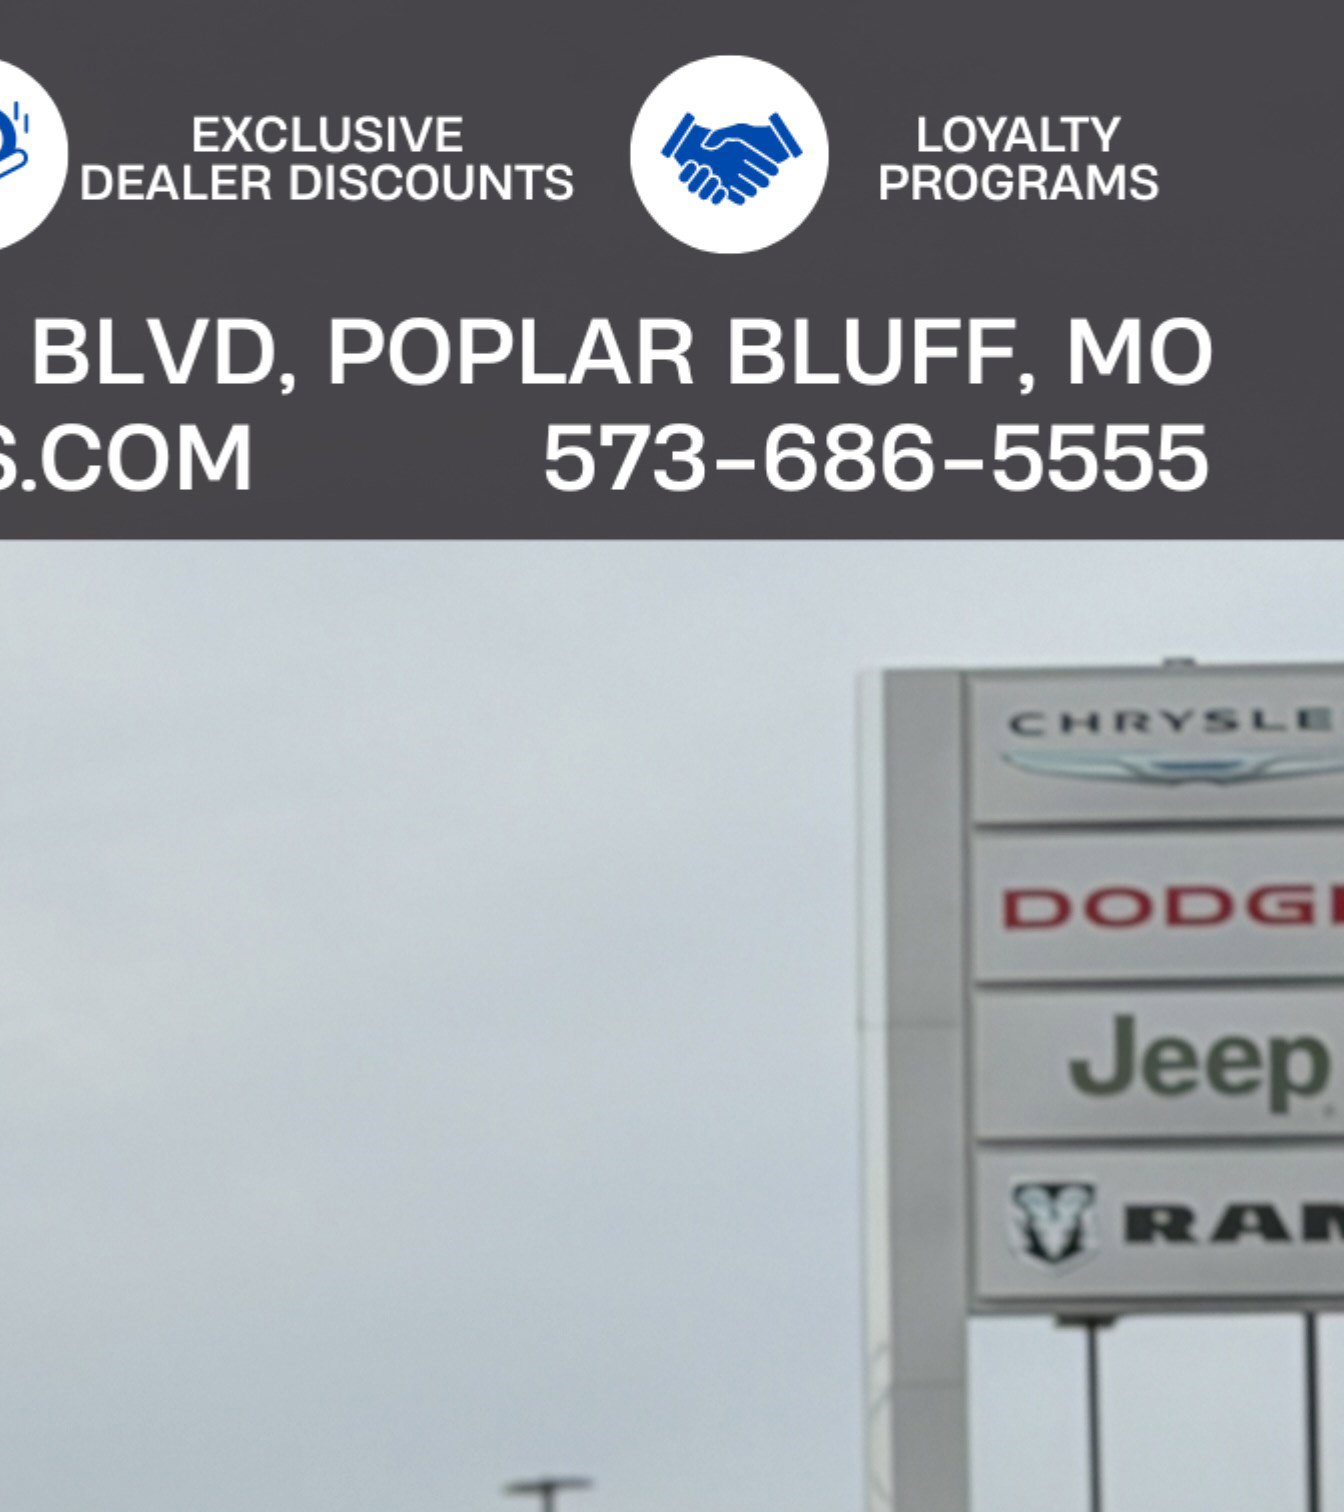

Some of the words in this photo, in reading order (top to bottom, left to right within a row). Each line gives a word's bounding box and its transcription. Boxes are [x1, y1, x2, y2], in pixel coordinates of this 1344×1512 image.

[1008, 706, 1344, 737] CHRYSLE
[1003, 884, 1344, 930] DODG
[1068, 1013, 1332, 1116] Jeep
